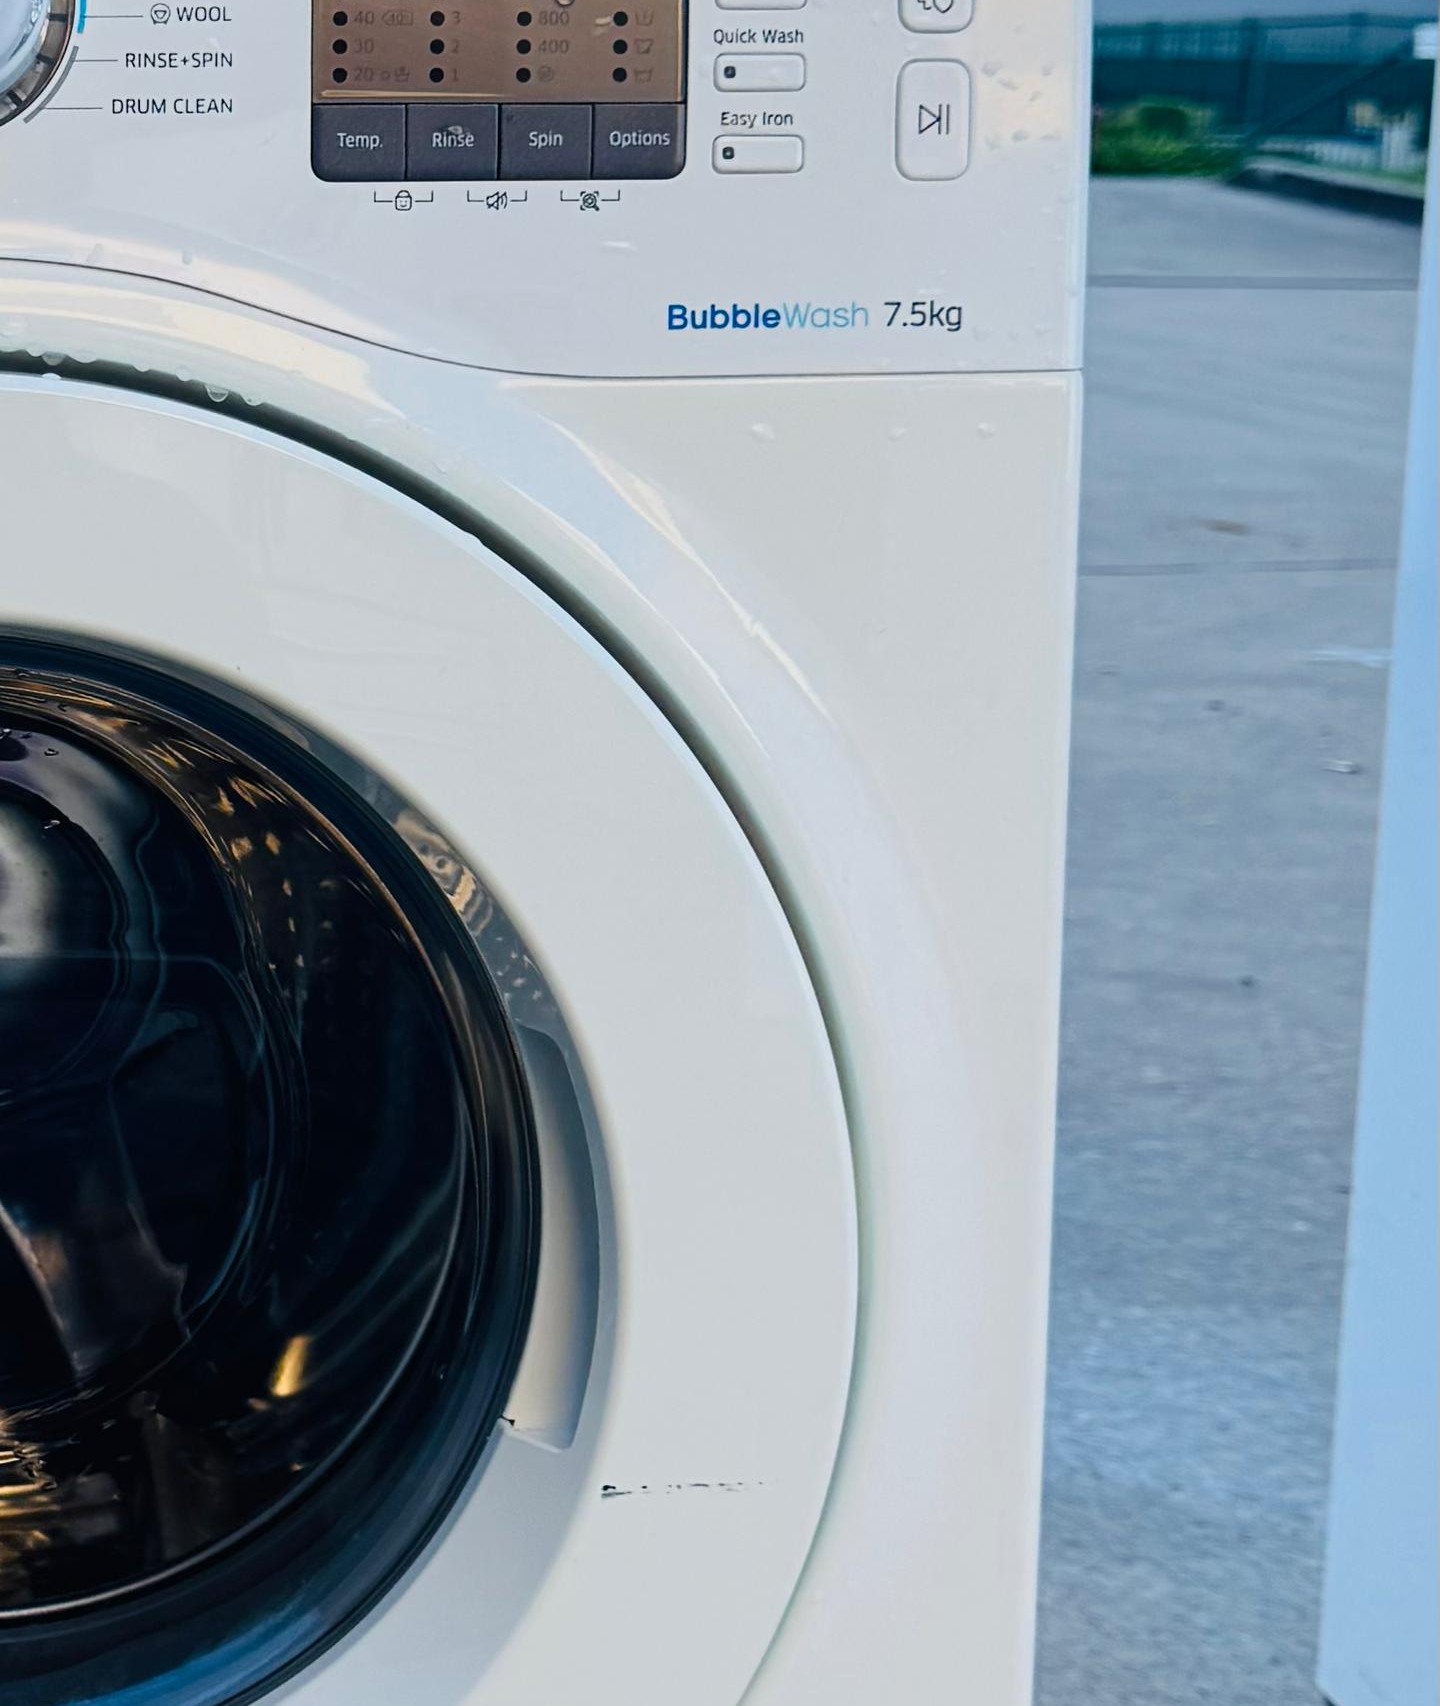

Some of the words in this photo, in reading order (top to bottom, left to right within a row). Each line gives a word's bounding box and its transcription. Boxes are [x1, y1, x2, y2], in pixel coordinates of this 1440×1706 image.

[176, 5, 232, 22] WOOL
[353, 10, 375, 26] 40
[538, 10, 570, 26] 800
[713, 28, 756, 45] Quick
[762, 28, 804, 44] Wash
[538, 38, 570, 54] 400
[124, 51, 233, 68] RINSE+SPIN
[111, 98, 167, 115] DRUM
[173, 98, 233, 115] CLEAN
[720, 110, 757, 129] Easy
[762, 110, 794, 127] Iron
[337, 132, 384, 150] Temp.
[432, 131, 475, 148] Rinse
[528, 130, 564, 147] Spin
[609, 130, 671, 147] Options
[667, 302, 868, 330] BubbleWash
[883, 301, 962, 332] 7.5kg
